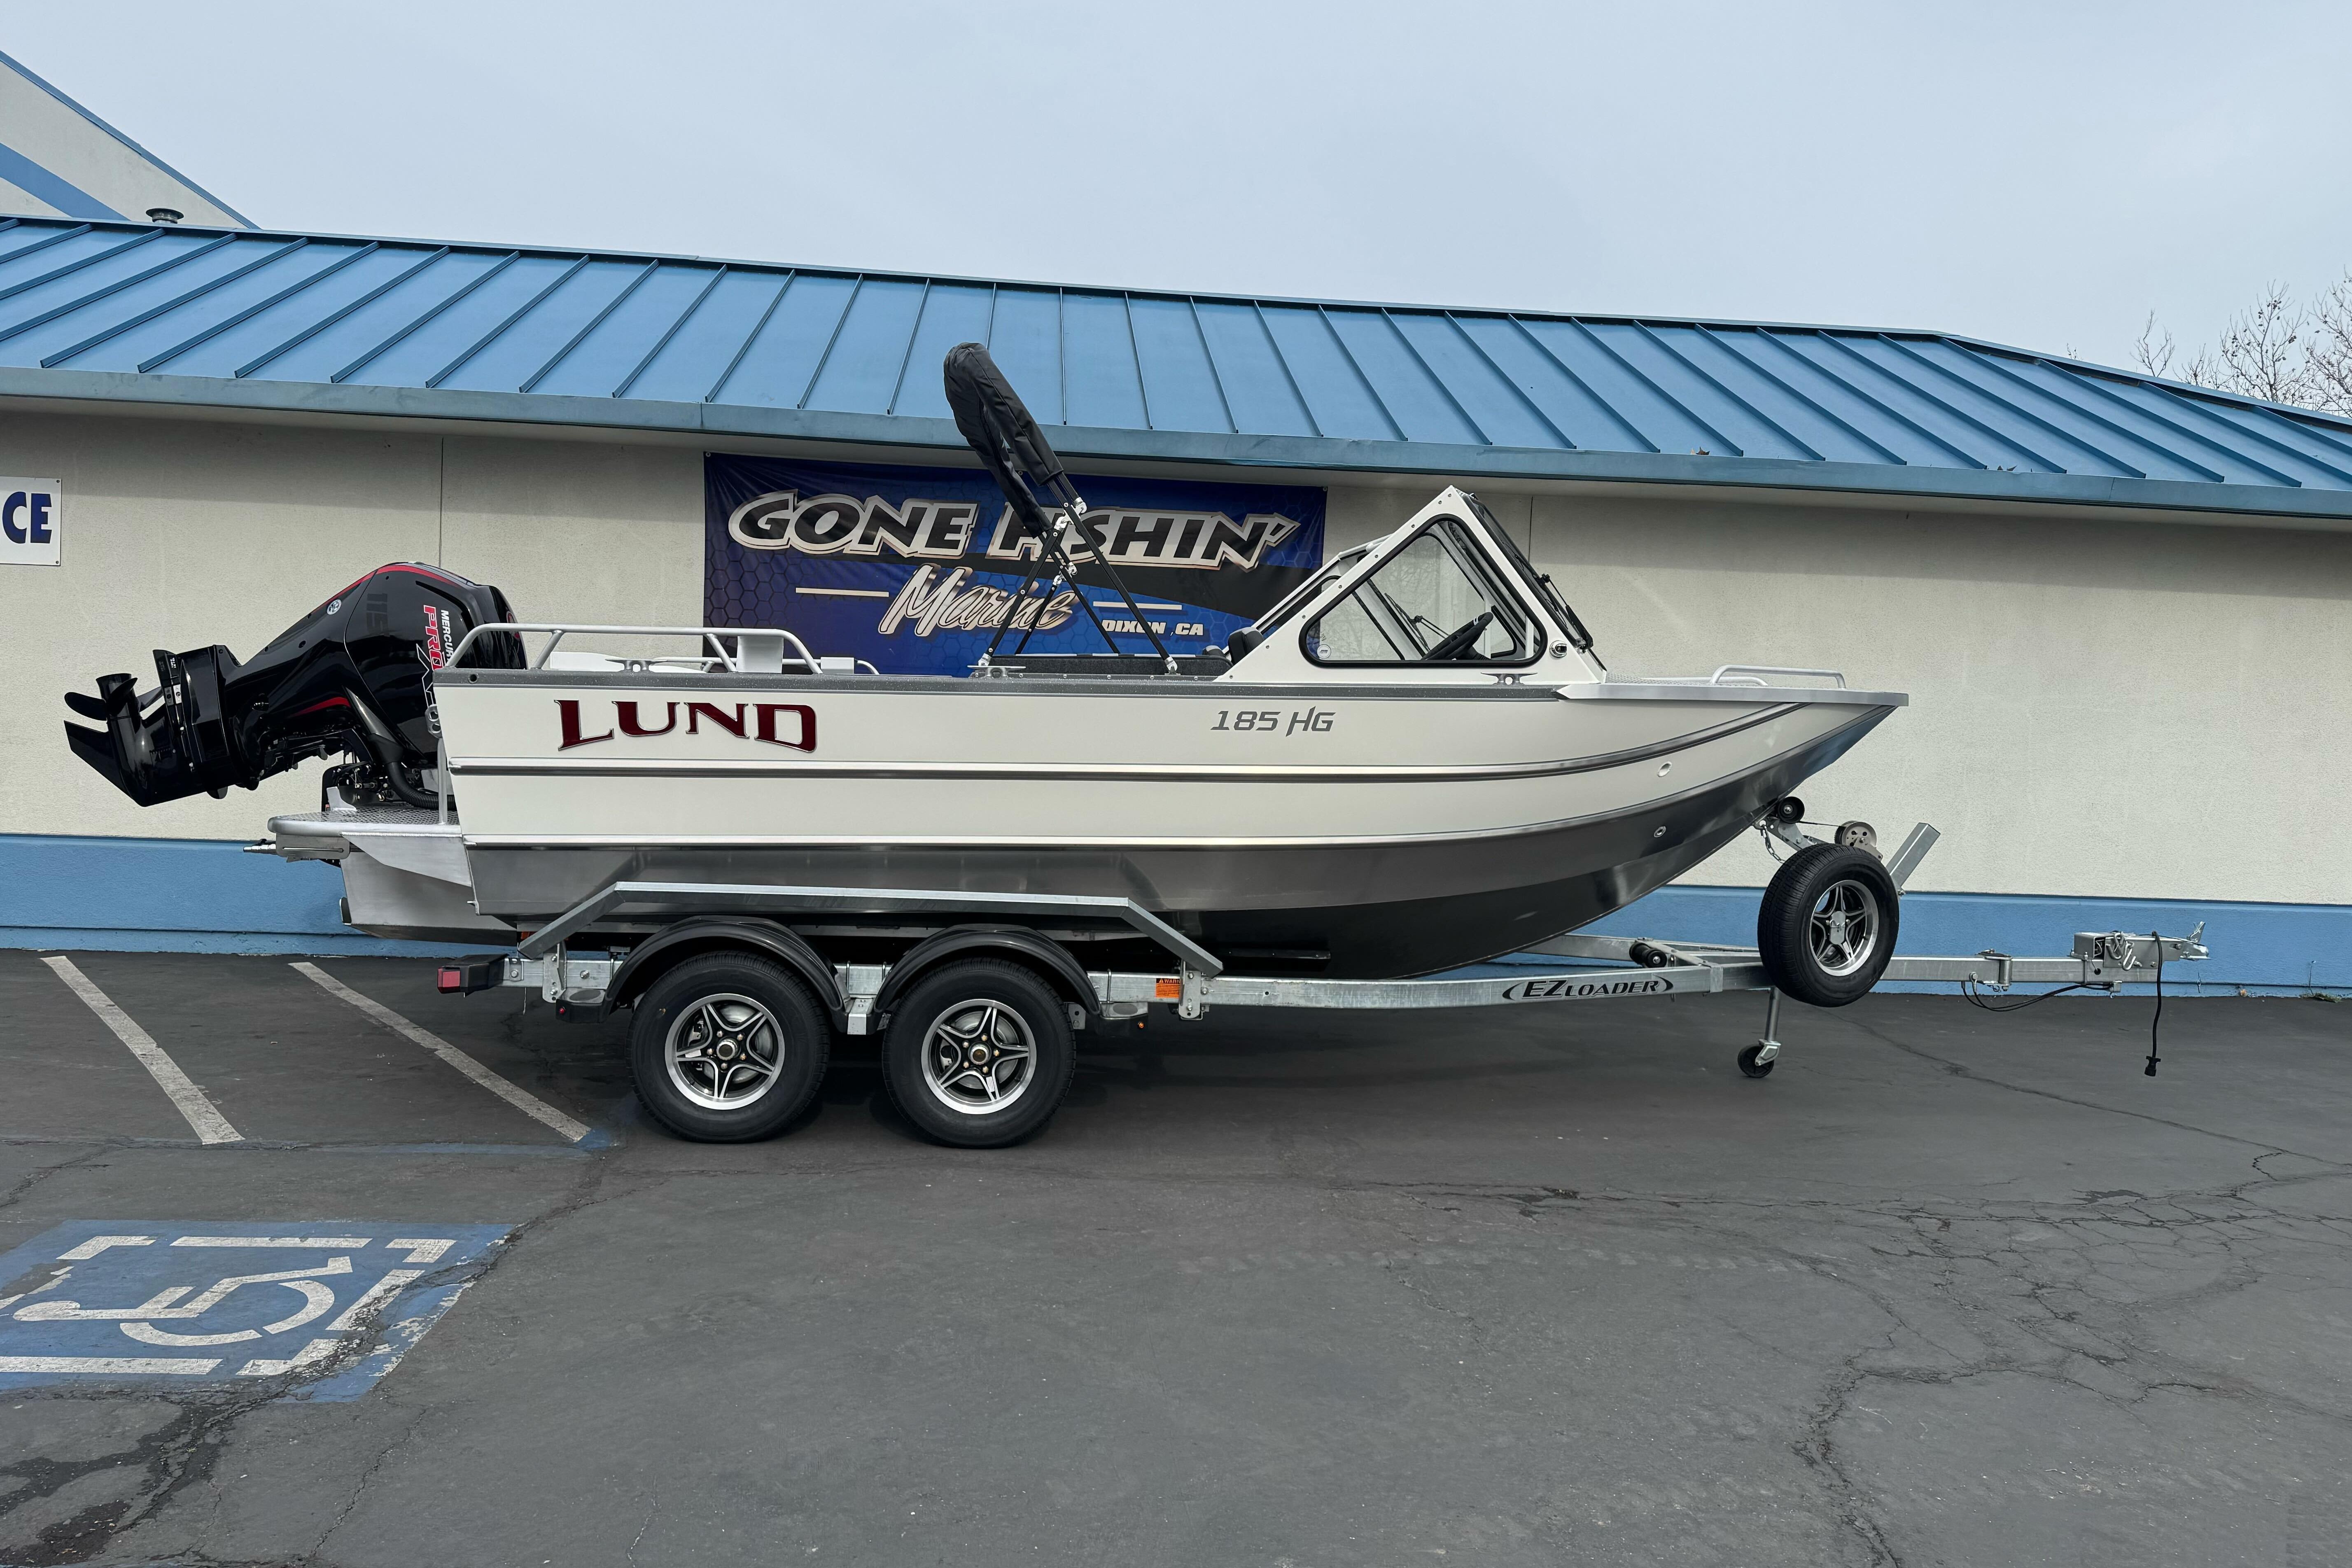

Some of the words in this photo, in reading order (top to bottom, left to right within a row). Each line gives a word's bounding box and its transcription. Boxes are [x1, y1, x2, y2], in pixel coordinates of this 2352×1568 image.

[2, 491, 52, 544] CE
[728, 490, 980, 557] GONE
[441, 610, 455, 661] MERCUR
[554, 699, 817, 753] LUND
[1210, 711, 1281, 731] 185
[1286, 706, 1336, 737] HG
